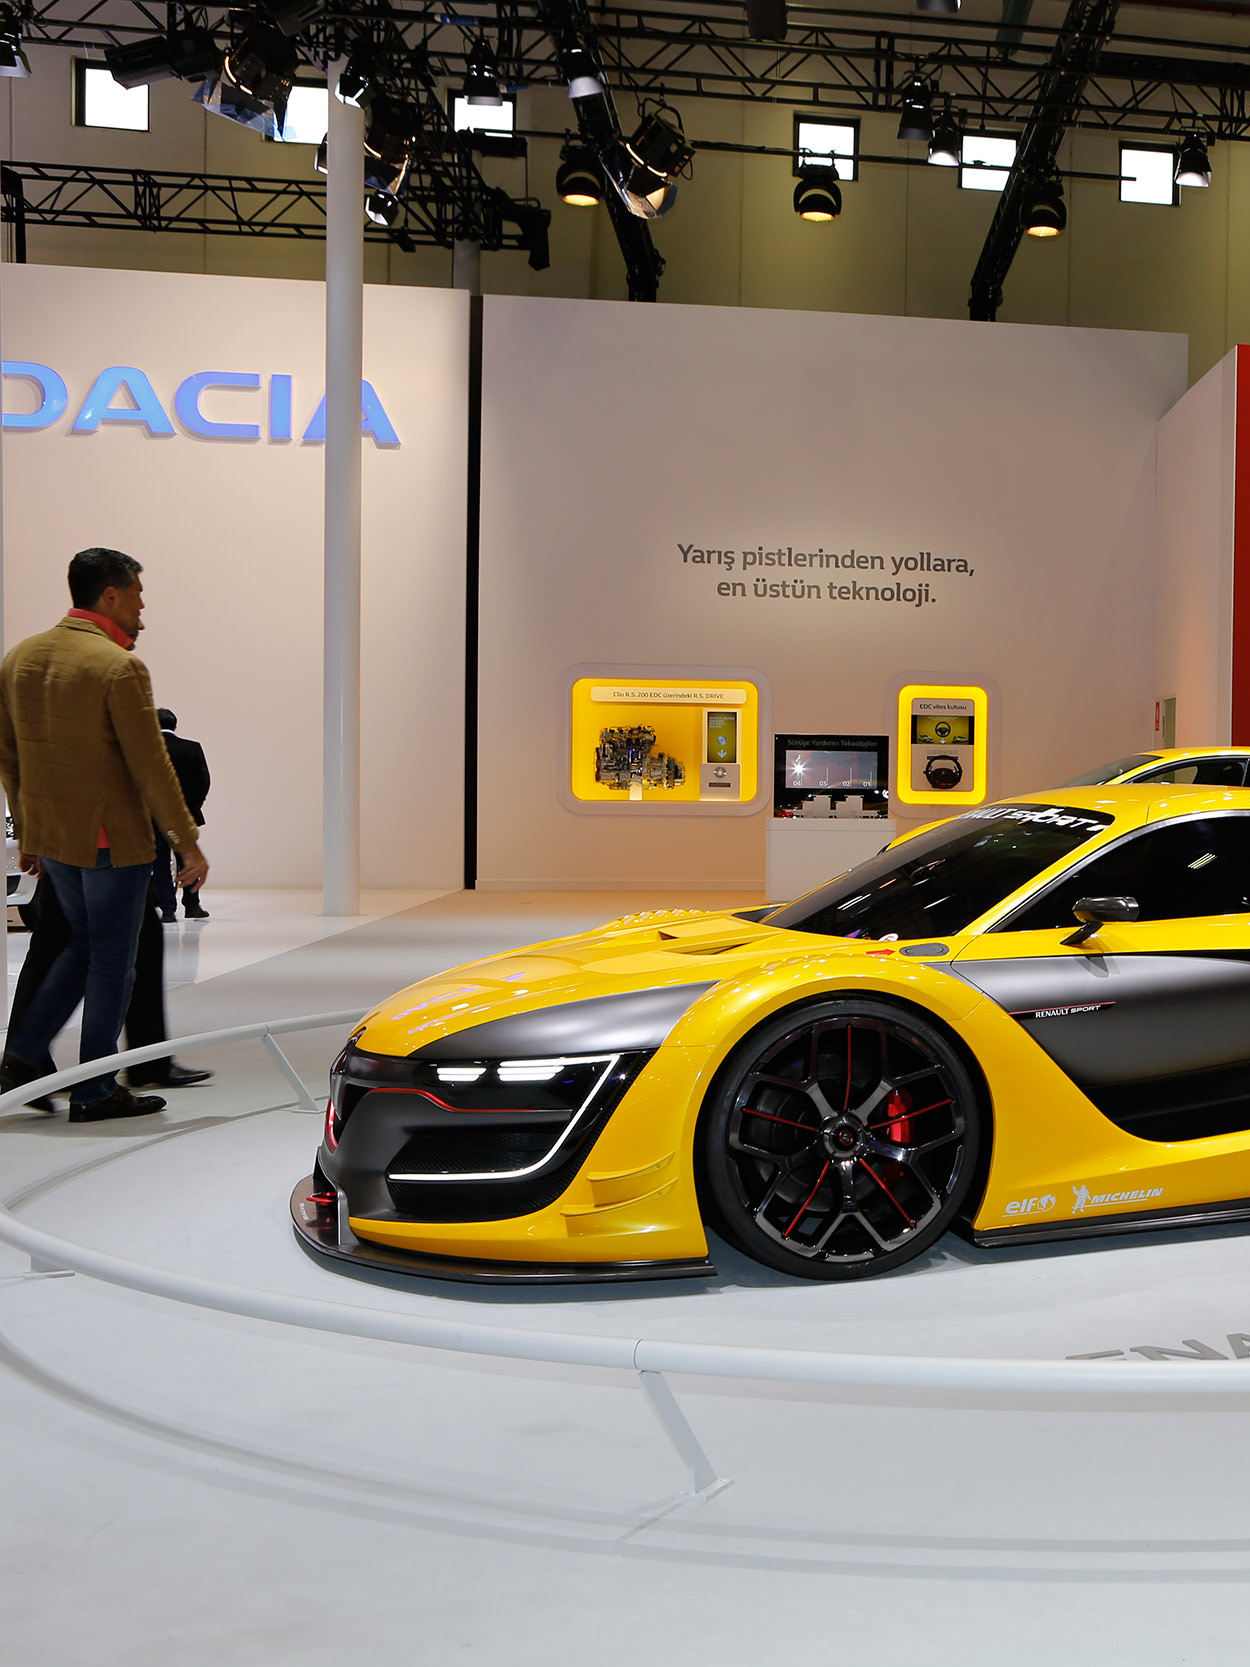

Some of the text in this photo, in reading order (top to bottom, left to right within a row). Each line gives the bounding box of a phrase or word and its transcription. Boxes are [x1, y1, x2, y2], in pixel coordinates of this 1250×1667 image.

[1, 360, 401, 449] DACIA
[677, 543, 975, 576] Yarış pistlerinden yollara,
[717, 577, 936, 607] en üstün teknoloji.
[1035, 1005, 1101, 1018] RENAULT SPORT
[1005, 1197, 1038, 1215] elf
[1090, 1188, 1164, 1204] MICHELIN
